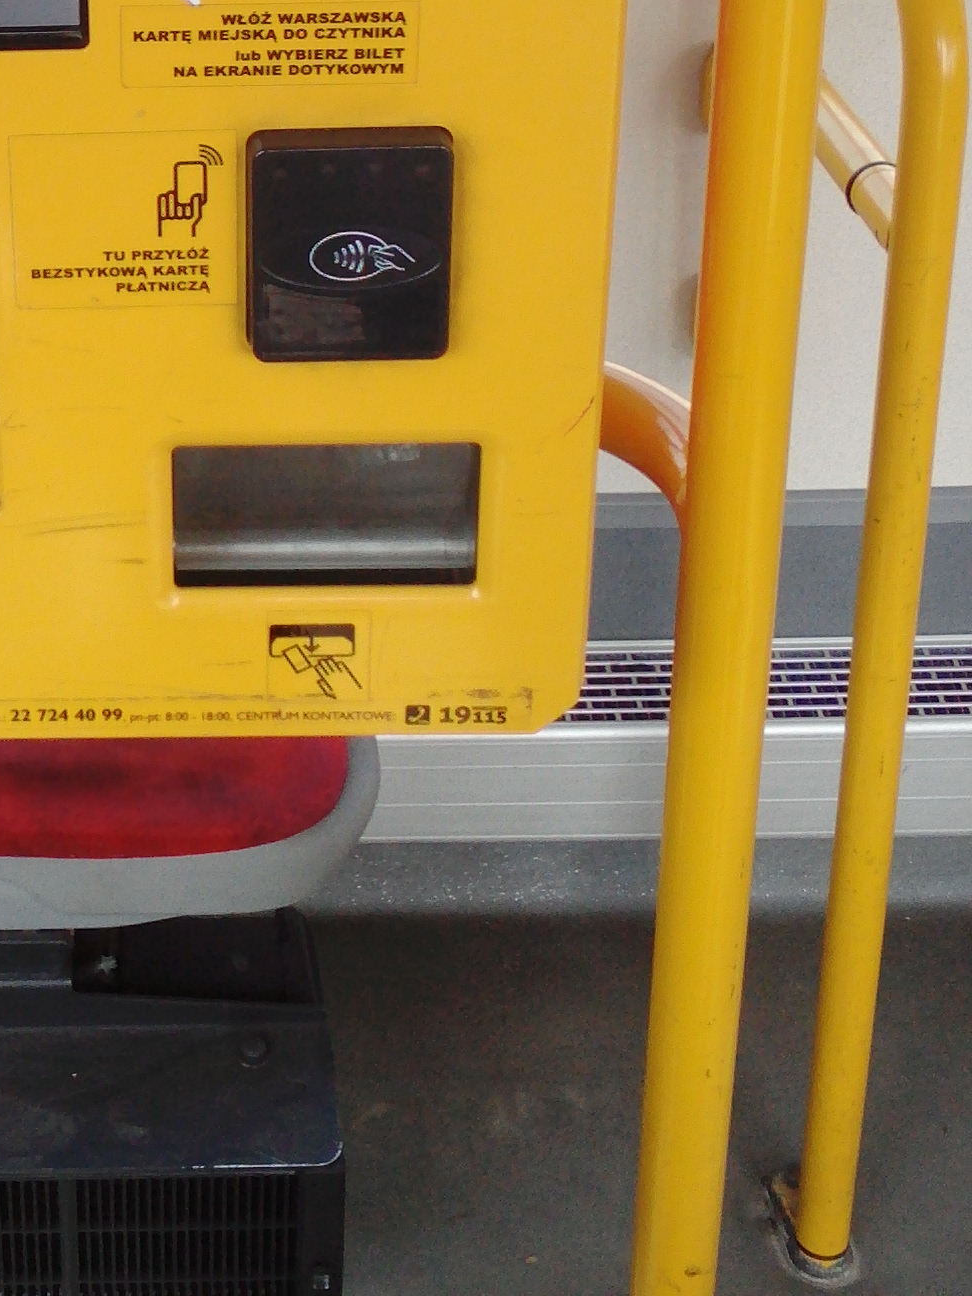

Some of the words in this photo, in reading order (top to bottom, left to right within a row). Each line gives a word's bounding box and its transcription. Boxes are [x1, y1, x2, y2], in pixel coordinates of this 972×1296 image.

[221, 10, 272, 26] WŁÓŻ
[278, 11, 406, 25] WARSZAWSKĄ
[133, 30, 192, 45] KARTĘ
[198, 28, 277, 43] MIEJSKĄ
[283, 28, 308, 40] DO
[314, 27, 406, 40] CZYTNIKA
[235, 49, 261, 62] lub
[266, 49, 348, 61] WYBIERZ
[354, 48, 405, 60] BILET
[173, 66, 198, 78] NA
[204, 65, 283, 77] EKRANIE
[288, 63, 404, 76] DOTYKOWYM
[102, 250, 126, 262] TU
[131, 247, 210, 261] PRZYŁÓŻ
[31, 266, 148, 280] BEZSTYKOWĄ
[152, 263, 210, 279] KARTĘ
[115, 280, 211, 294] PŁATNICZĄ
[10, 709, 31, 722] 22
[37, 708, 68, 722] 724
[74, 708, 96, 722] 40
[236, 710, 299, 722] CENTRUM
[439, 705, 508, 725] 19115
